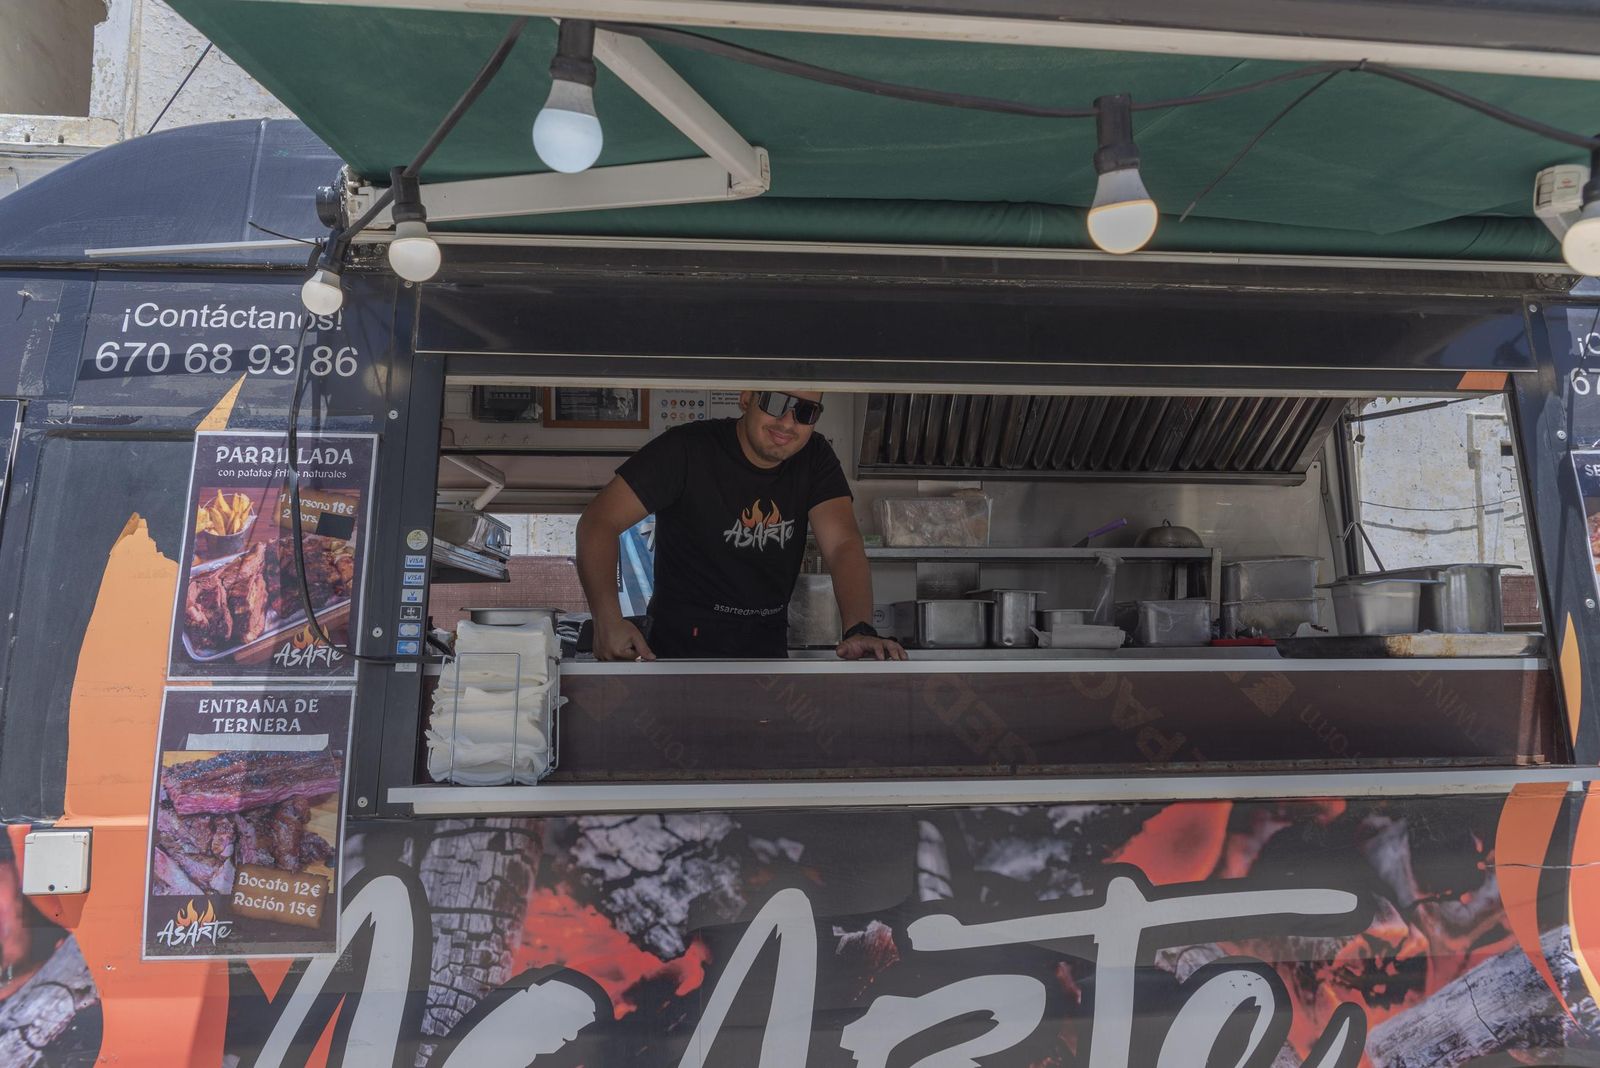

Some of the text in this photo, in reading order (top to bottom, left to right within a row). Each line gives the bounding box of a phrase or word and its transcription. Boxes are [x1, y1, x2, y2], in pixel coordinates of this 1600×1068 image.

[121, 302, 344, 332] ¡Contáctanos!
[95, 342, 359, 377] 670 68 93 86
[215, 446, 354, 465] PARRILLADA
[218, 468, 347, 479] con patatas frits naturales
[332, 501, 355, 515] 18€
[198, 696, 319, 714] ENTRAÑA DE
[212, 717, 302, 733] TERNERA
[238, 872, 322, 898] Bocata 12€
[233, 891, 318, 918] Ración 15€
